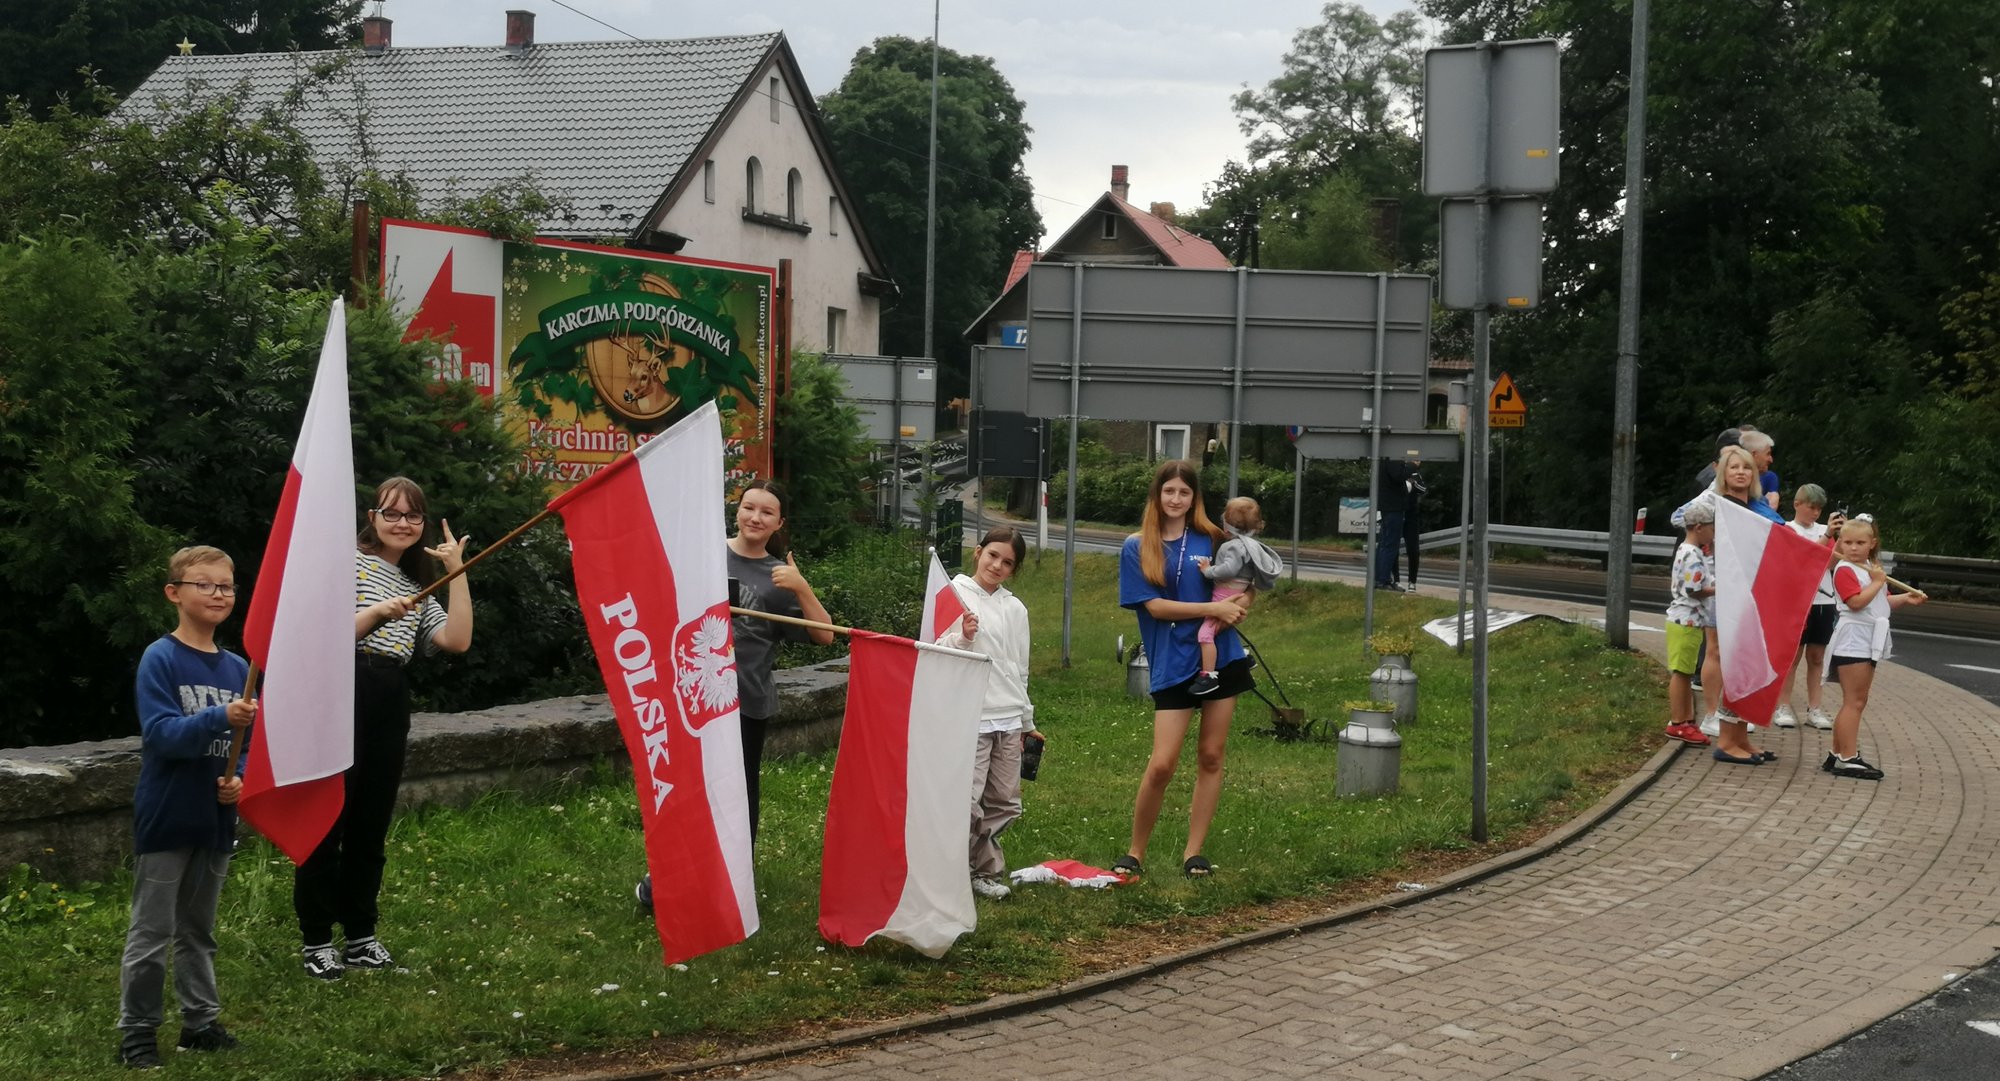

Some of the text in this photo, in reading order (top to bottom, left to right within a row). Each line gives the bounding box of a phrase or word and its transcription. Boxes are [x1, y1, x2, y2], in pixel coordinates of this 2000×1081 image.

[545, 301, 731, 358] KARCZMA PODGÓRZANKA
[470, 361, 491, 388] m
[757, 285, 768, 441] www.podgorzanka.com.pl
[529, 421, 629, 451] Kuchnia
[600, 591, 674, 815] POLSKA
